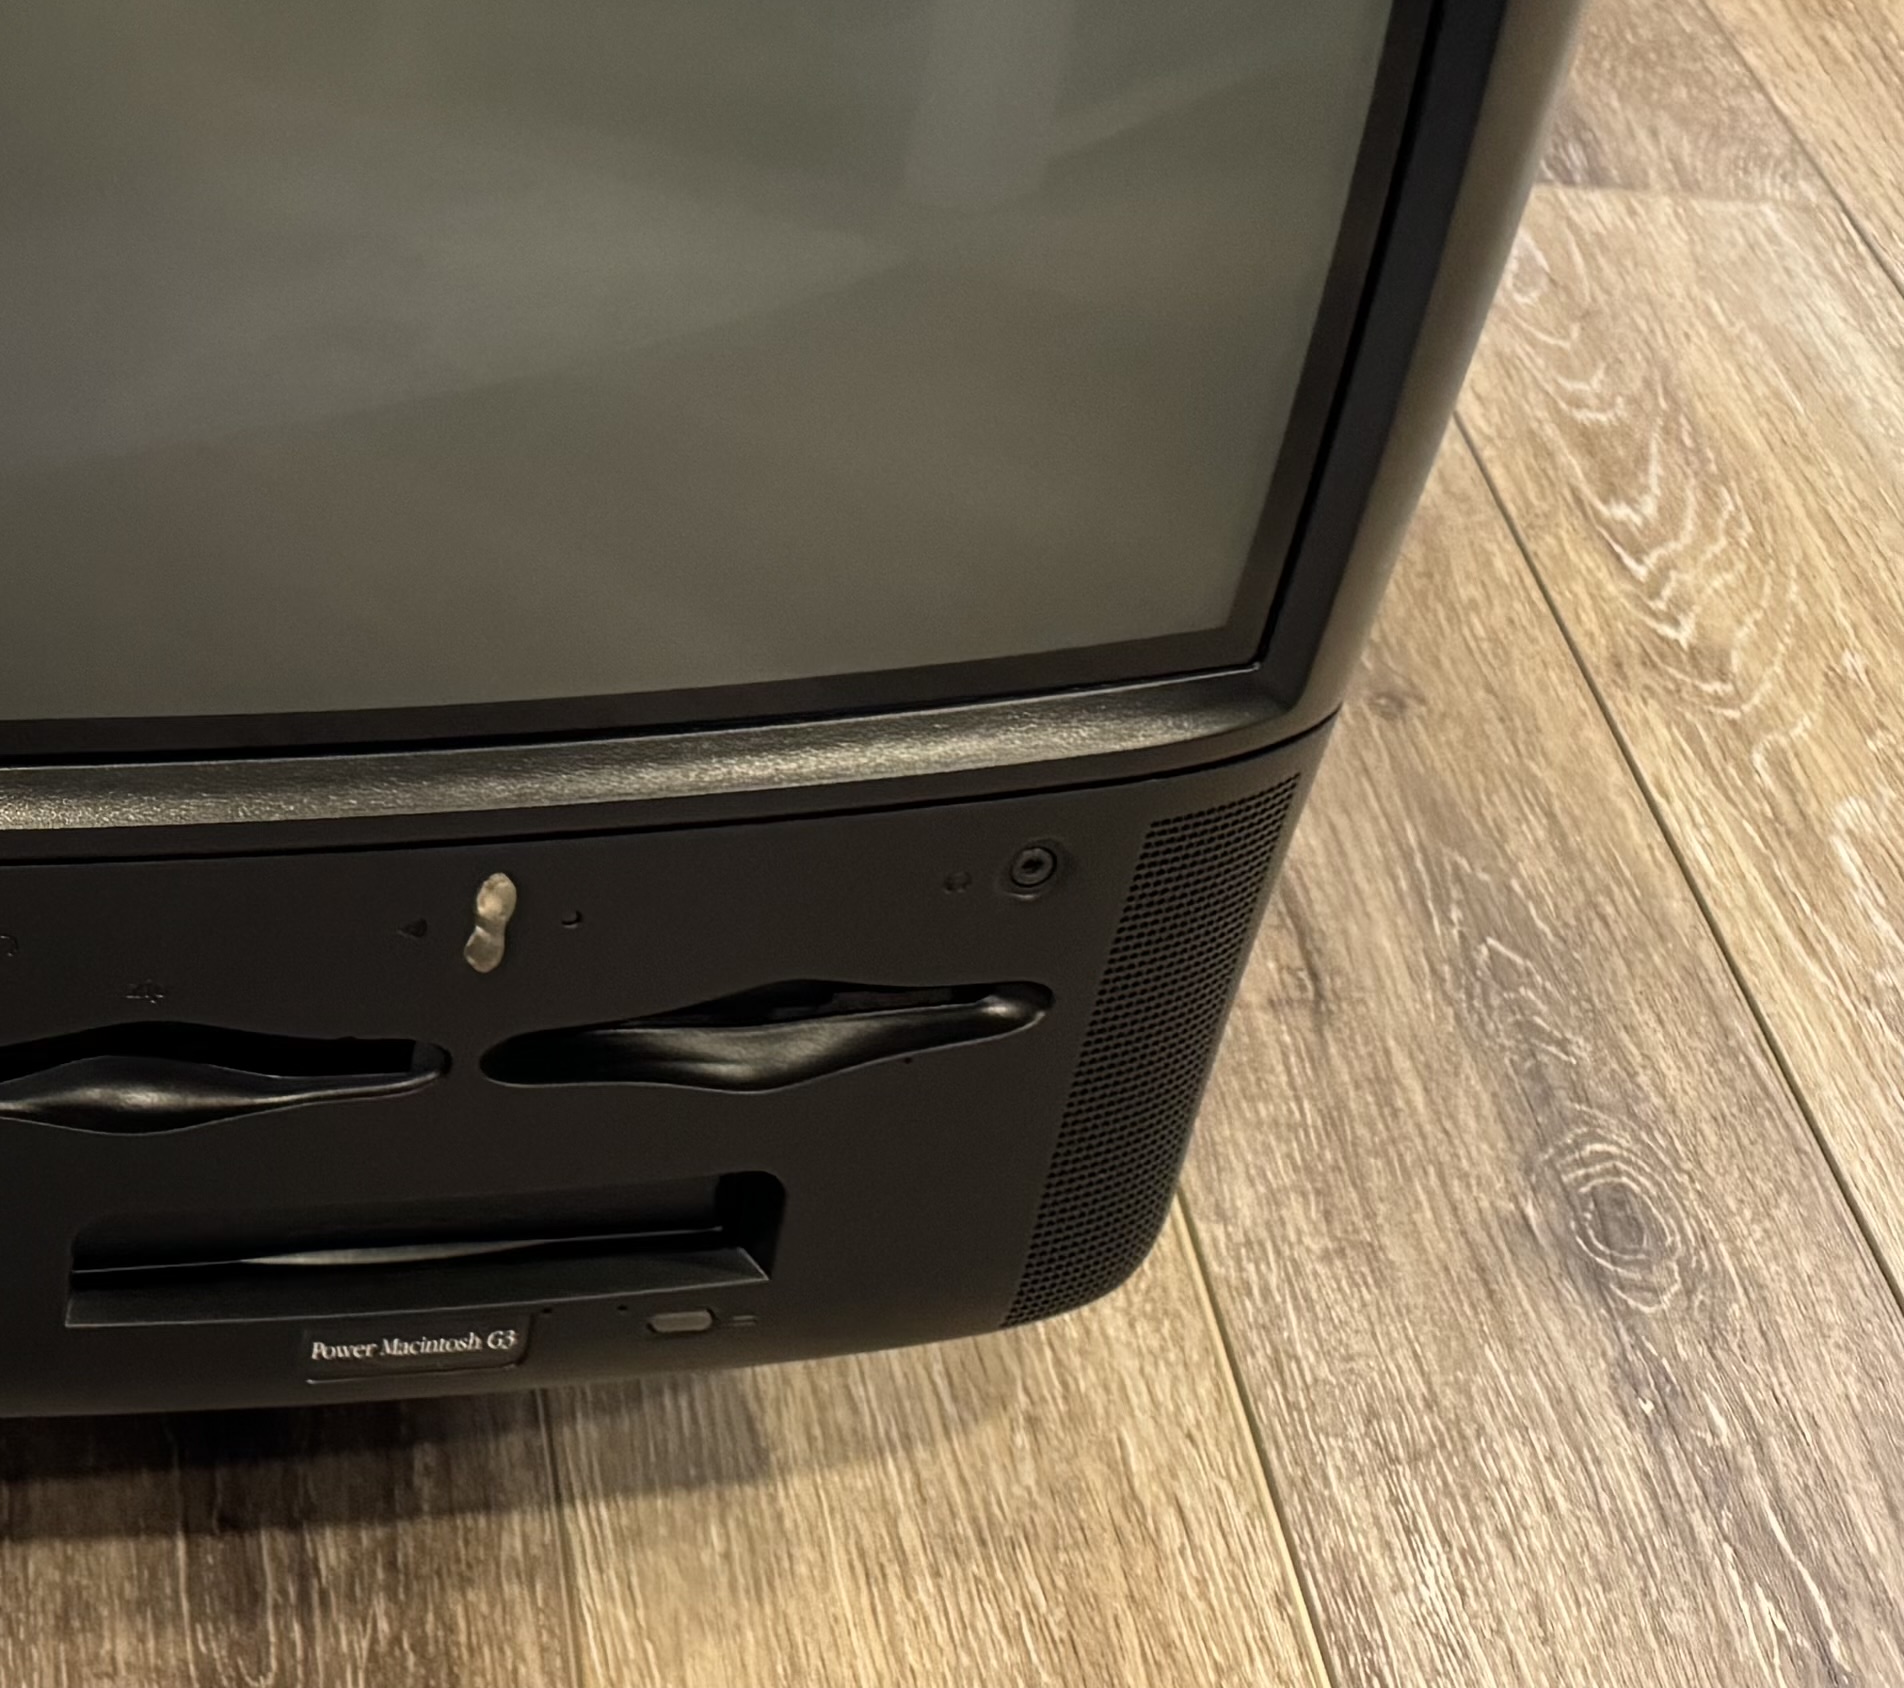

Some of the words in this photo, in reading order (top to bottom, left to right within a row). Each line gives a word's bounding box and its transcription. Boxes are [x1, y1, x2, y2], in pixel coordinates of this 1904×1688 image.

[310, 1341, 378, 1360] Power
[379, 1332, 483, 1356] Macintosh
[486, 1329, 518, 1351] G3
